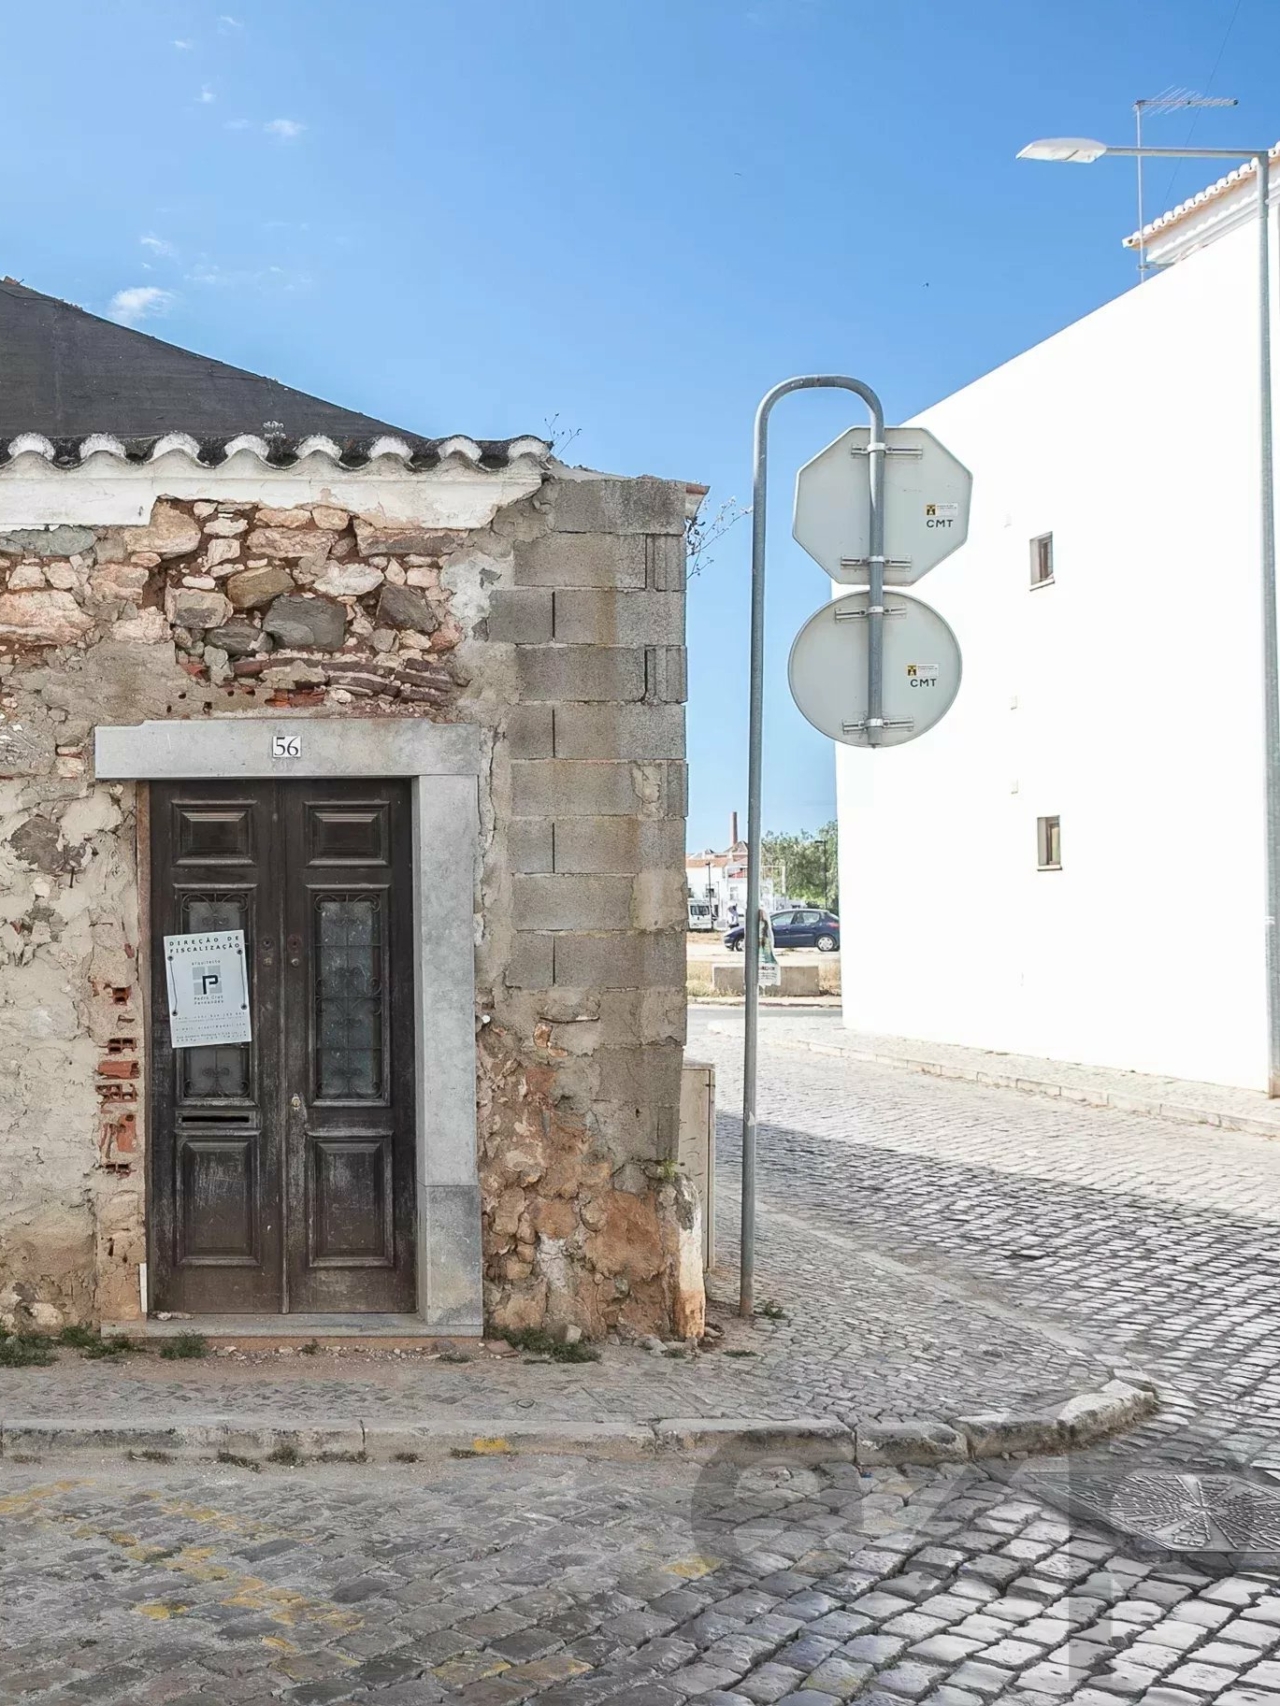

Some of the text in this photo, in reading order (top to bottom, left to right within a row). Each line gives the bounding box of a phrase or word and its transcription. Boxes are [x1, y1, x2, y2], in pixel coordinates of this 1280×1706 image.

[926, 519, 954, 528] CMT
[910, 678, 937, 688] CMT
[274, 736, 299, 756] 56
[169, 936, 219, 947] DIREÇÃO
[169, 943, 240, 954] FISCALIZAÇÃO
